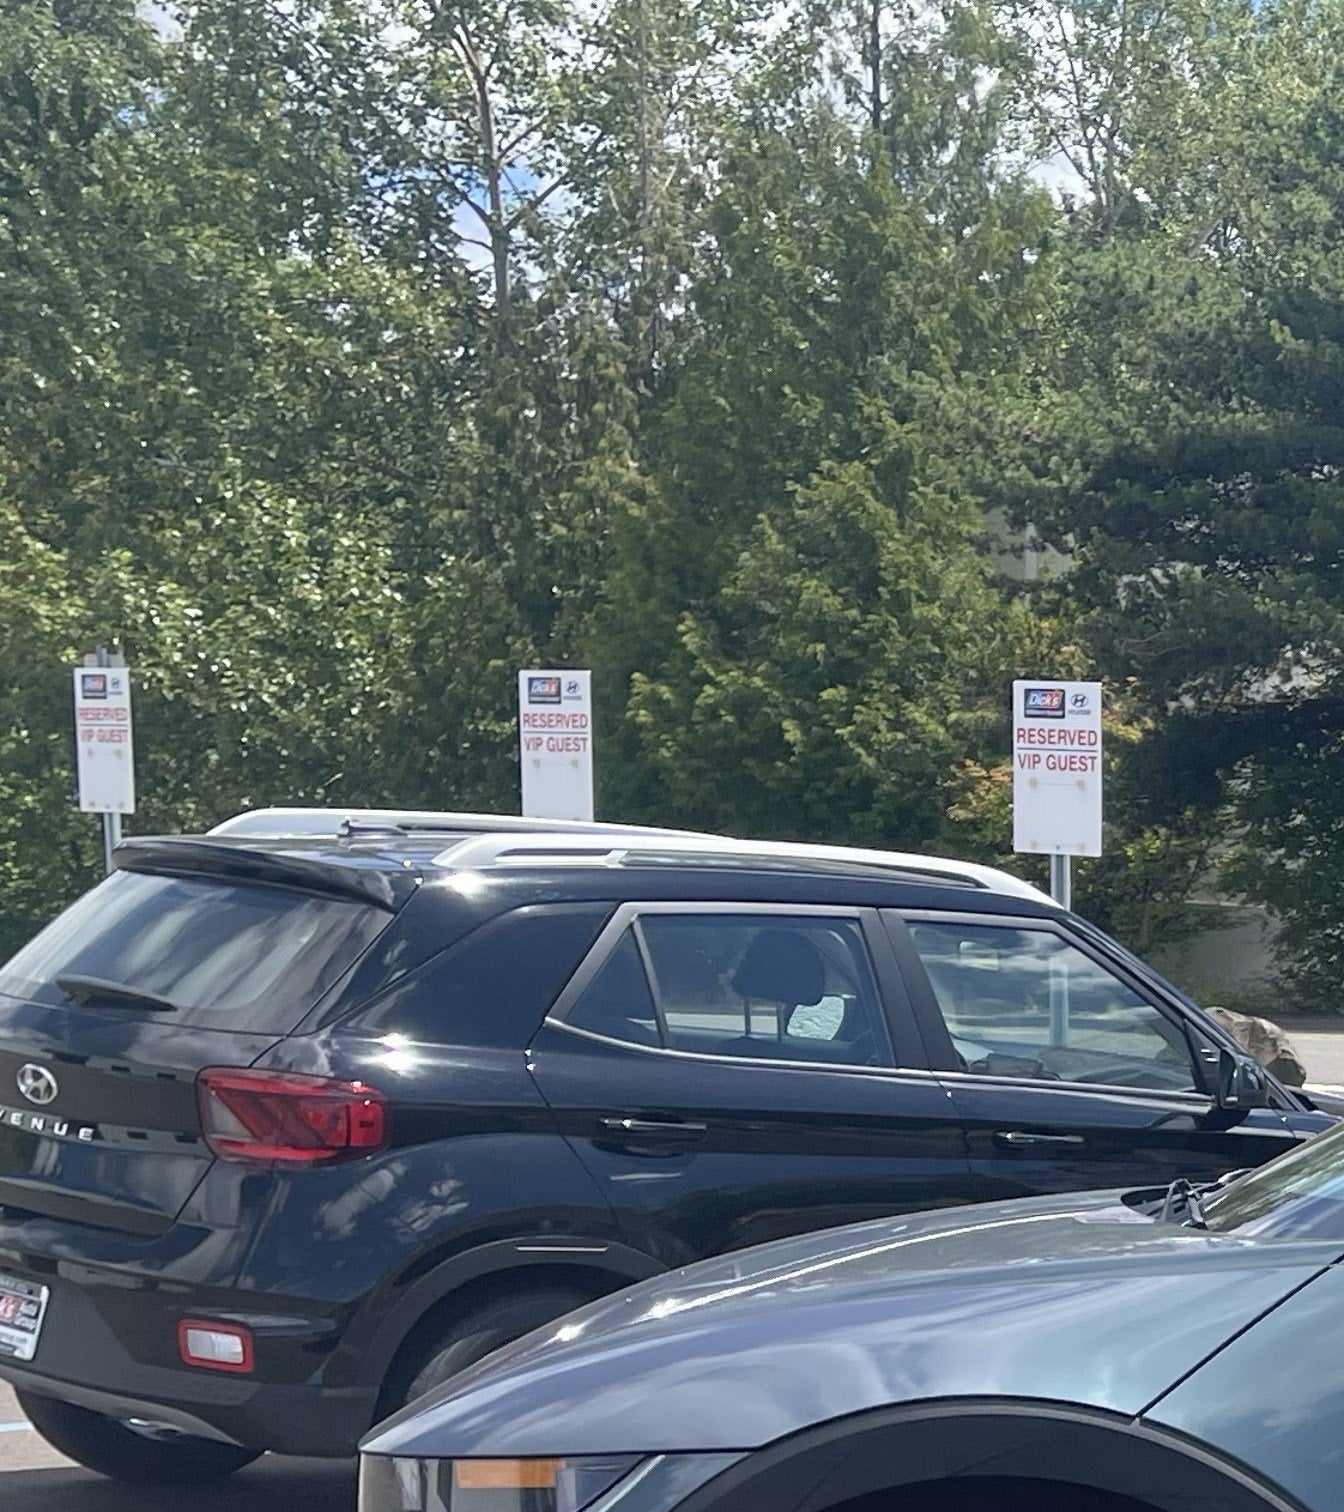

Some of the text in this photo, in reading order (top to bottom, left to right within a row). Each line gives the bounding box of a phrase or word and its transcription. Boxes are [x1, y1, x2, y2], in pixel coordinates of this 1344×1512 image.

[523, 713, 588, 729] RESERVED
[524, 736, 588, 752] VIP GUEST
[1016, 727, 1098, 747] RESERVED
[1018, 753, 1098, 772] VIP GUEST
